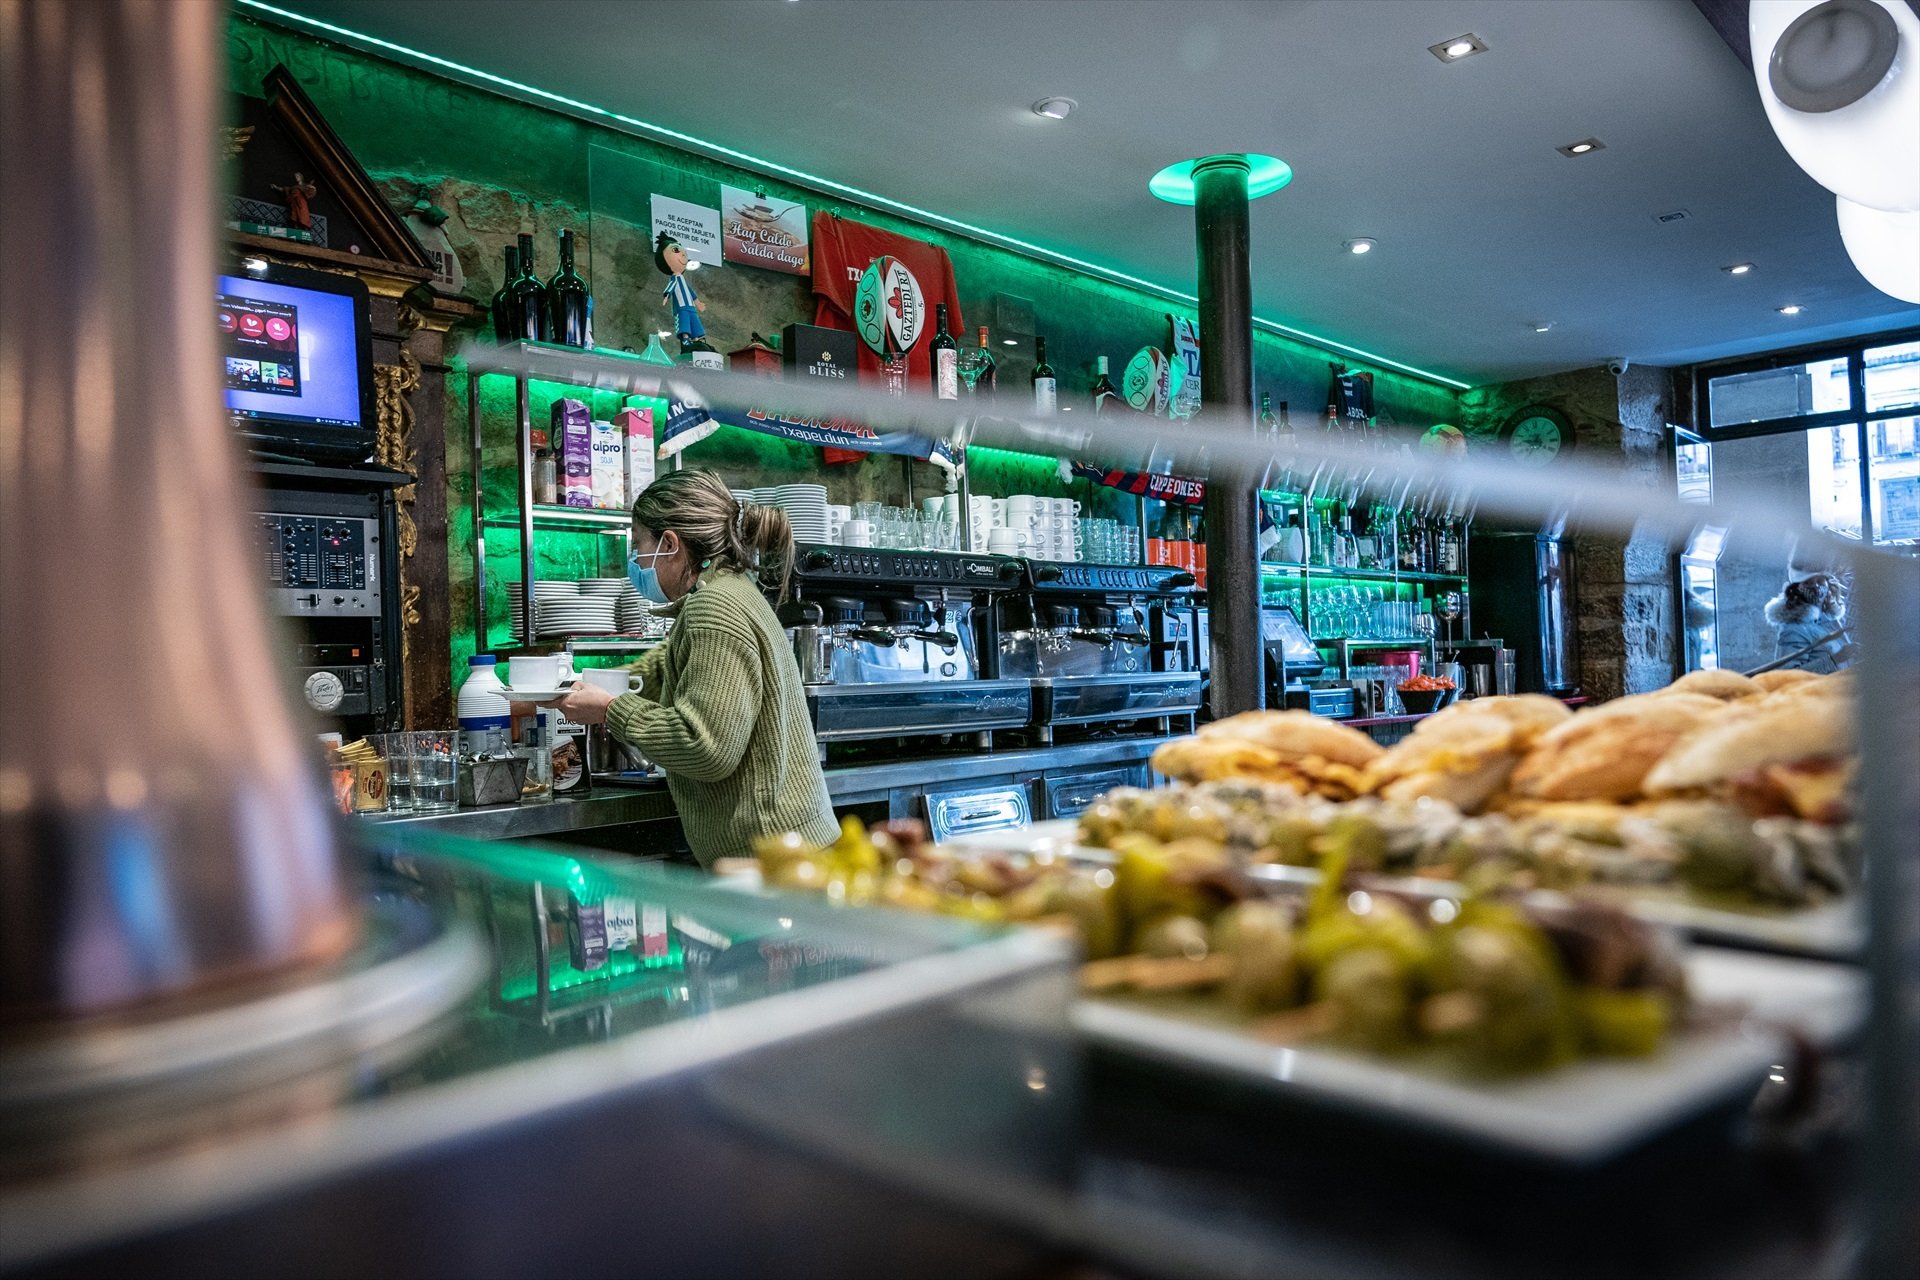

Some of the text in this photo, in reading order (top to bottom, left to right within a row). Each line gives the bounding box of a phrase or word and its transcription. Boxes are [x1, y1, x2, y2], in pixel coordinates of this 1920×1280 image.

[655, 219, 716, 239] PAGOS CON TARJETA
[676, 216, 704, 228] ACEPTAN
[668, 230, 690, 241] PARTIR
[691, 235, 700, 243] DE
[700, 237, 710, 246] 10€
[729, 221, 793, 248] Hay Caldo
[740, 241, 804, 268] Salda dago
[901, 288, 913, 341] GAZTEDI
[809, 365, 845, 379] BLISS
[816, 361, 837, 369] ROYAL
[592, 441, 621, 455] alpro
[1150, 474, 1203, 498] CAMPEONES
